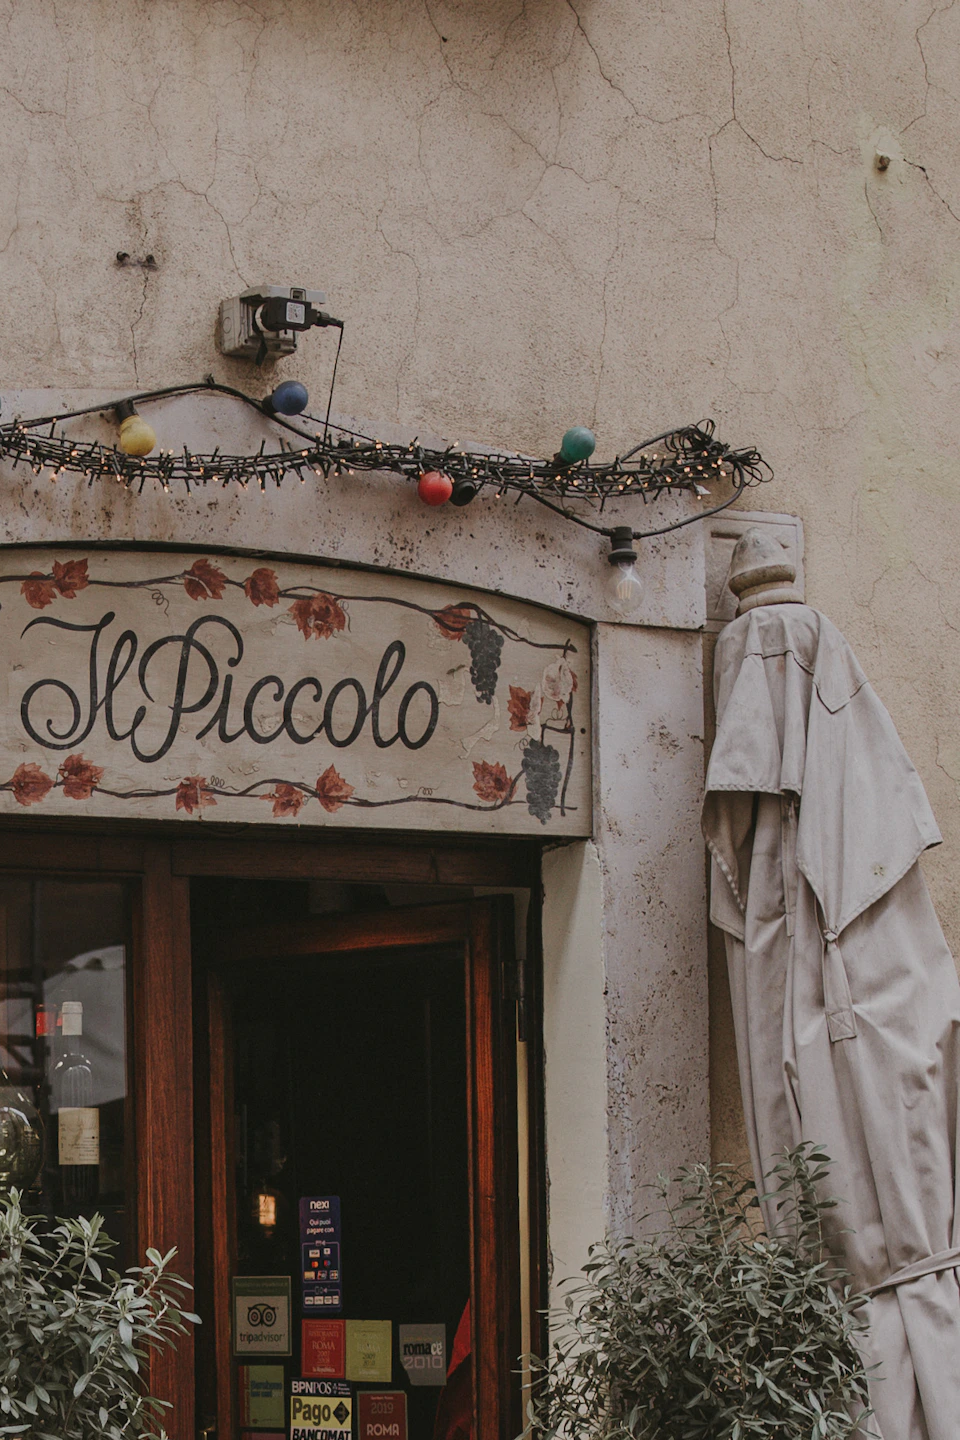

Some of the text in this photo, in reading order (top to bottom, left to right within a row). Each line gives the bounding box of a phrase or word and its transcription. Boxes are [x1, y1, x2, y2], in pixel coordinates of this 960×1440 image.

[20, 611, 439, 764] Il Piccolo
[309, 1200, 330, 1210] nexi
[239, 1331, 283, 1345] tripadvisor
[312, 1341, 336, 1350] ROMA
[403, 1356, 443, 1369] 2010
[292, 1397, 331, 1426] Pago
[371, 1402, 394, 1414] 2019
[366, 1423, 399, 1436] ROMA
